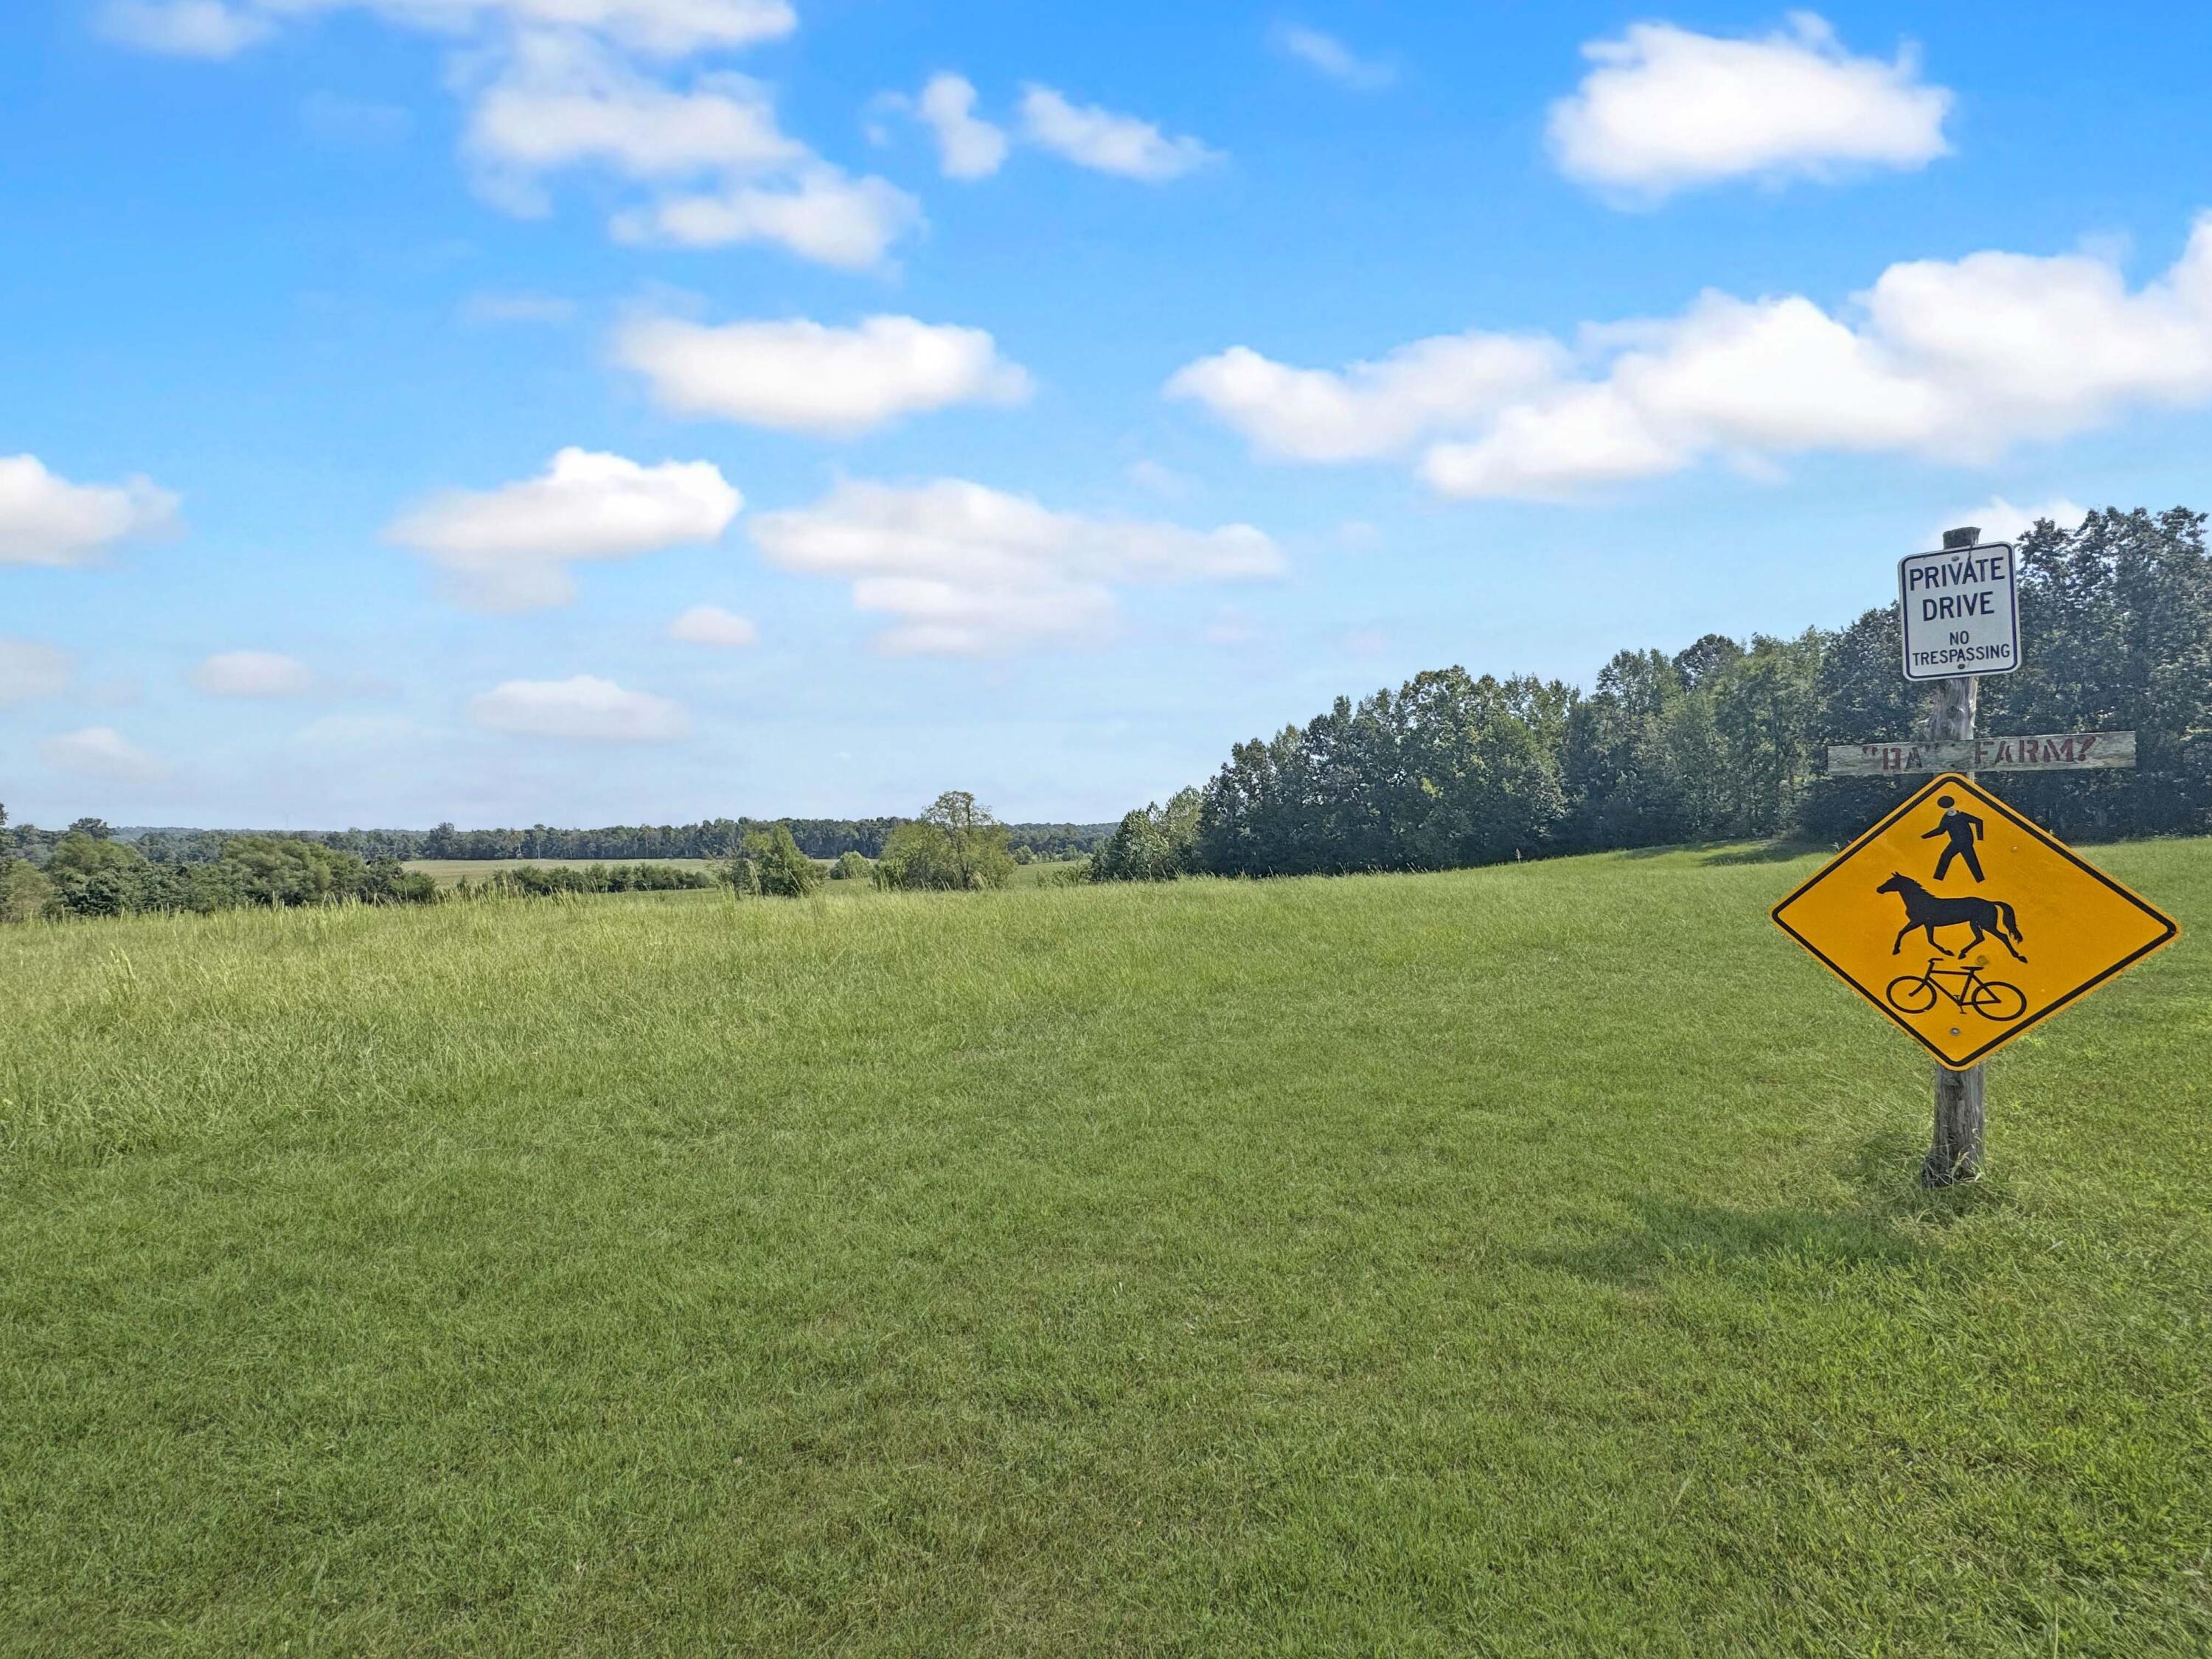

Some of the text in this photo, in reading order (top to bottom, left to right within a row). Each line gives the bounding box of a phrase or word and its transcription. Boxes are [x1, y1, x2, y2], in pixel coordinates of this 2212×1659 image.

[1910, 557, 2005, 591] PRIVATE
[1923, 591, 1994, 621] DRIVE
[1950, 630, 1969, 645] NO
[1913, 644, 2010, 666] TRESPASSING
